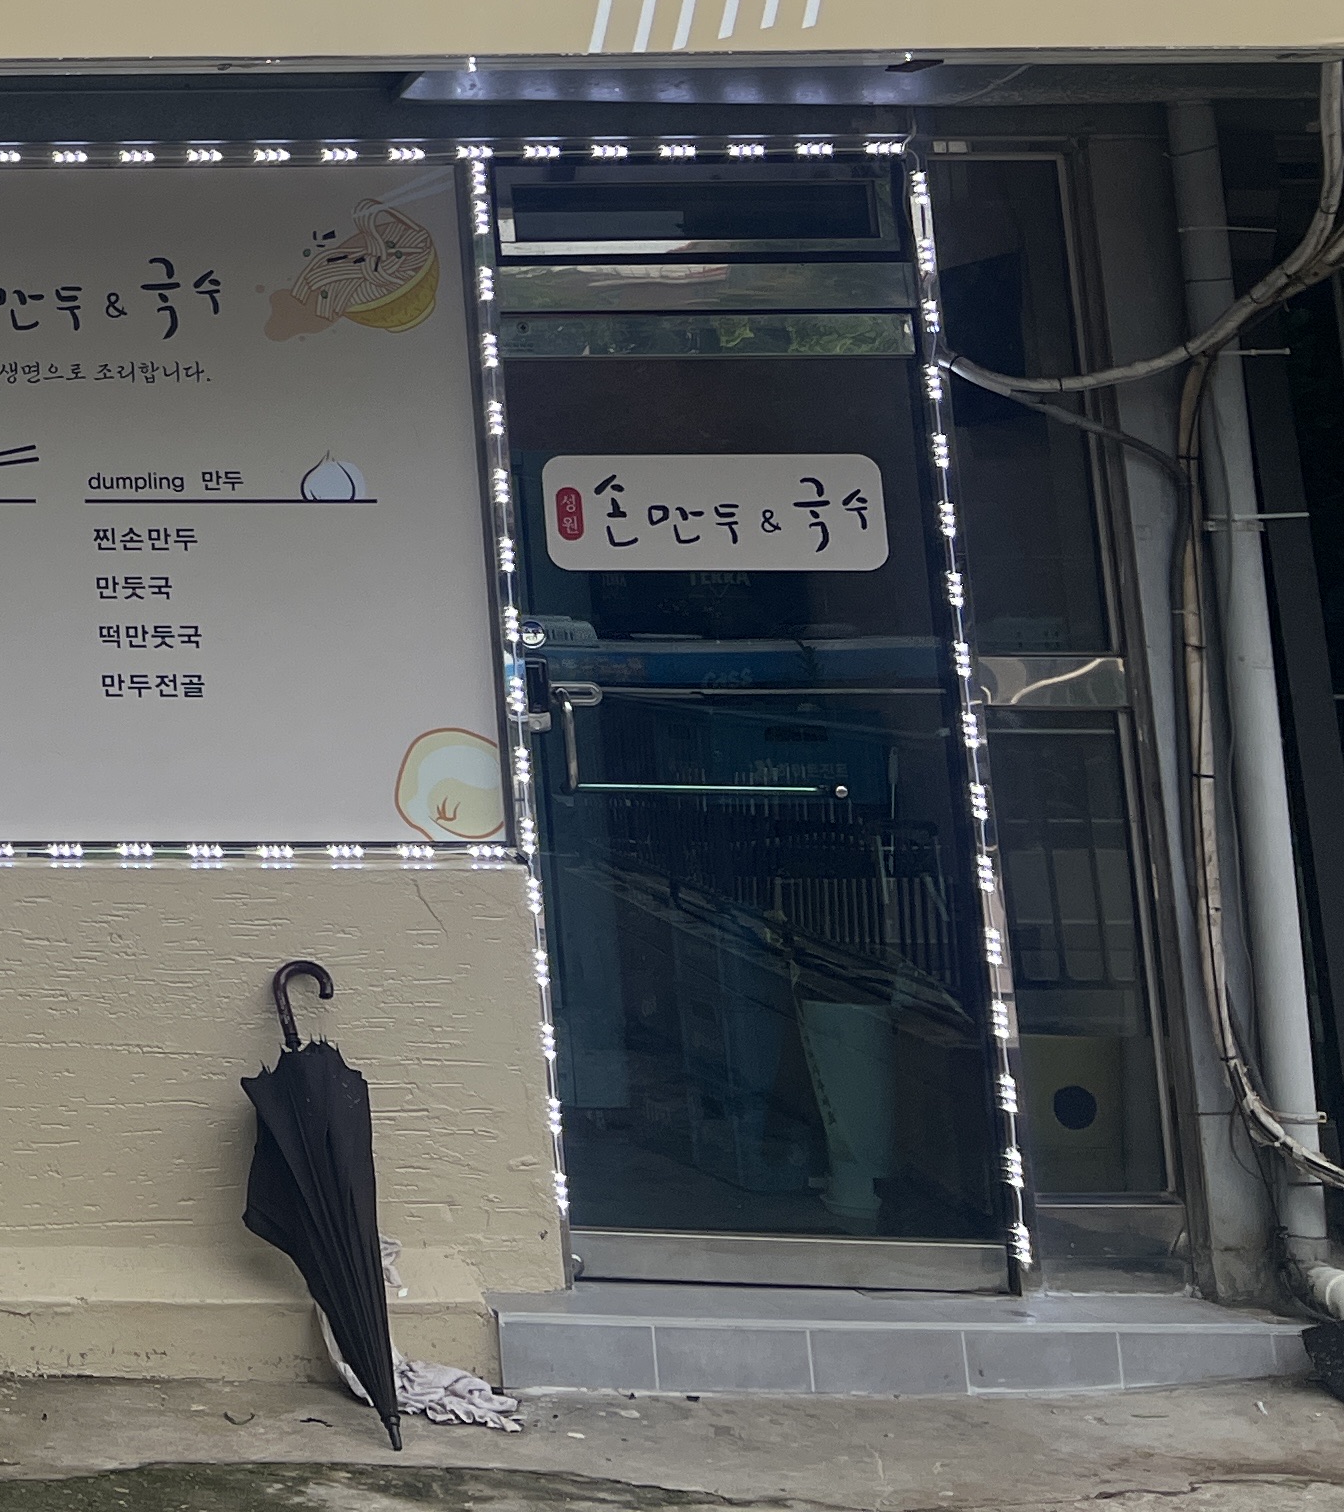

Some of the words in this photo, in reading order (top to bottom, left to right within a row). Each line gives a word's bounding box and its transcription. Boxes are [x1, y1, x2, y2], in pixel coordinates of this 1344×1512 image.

[105, 292, 128, 319] &
[140, 257, 222, 340] 국수
[93, 360, 212, 385] 조리합니다.
[88, 471, 185, 493] dumpling
[201, 470, 244, 491] 만두
[561, 493, 579, 536] 성원
[594, 474, 740, 548] 손만두
[761, 509, 782, 534] &
[792, 477, 869, 553] 국수
[93, 527, 198, 552] 찐손만두
[95, 575, 173, 600] 만둣국
[98, 624, 203, 649] 떡만둣국
[101, 673, 206, 698] 만두전골
